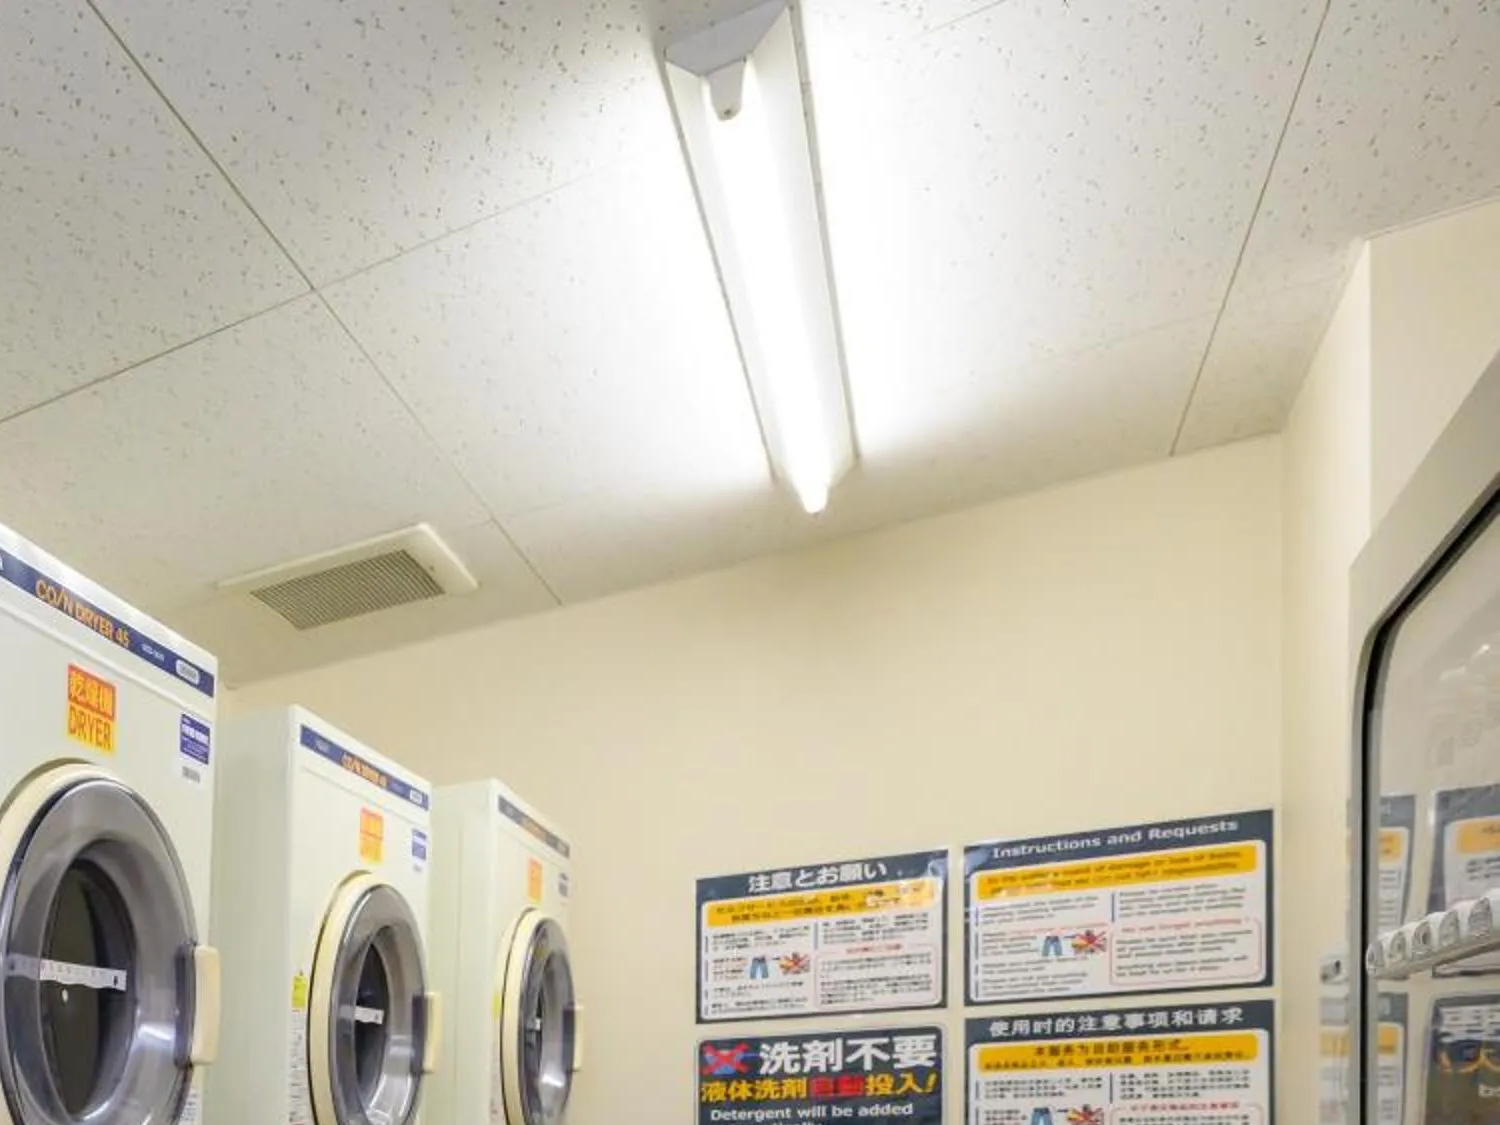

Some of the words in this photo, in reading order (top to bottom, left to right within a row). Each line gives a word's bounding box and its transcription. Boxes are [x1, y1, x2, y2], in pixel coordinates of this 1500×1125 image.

[75, 602, 114, 641] DRYER
[68, 706, 112, 750] DRYER
[992, 837, 1100, 859] Instructions
[1107, 829, 1142, 845] and
[1148, 819, 1238, 841] Requests
[748, 862, 886, 893] 注意とお願い
[989, 1007, 1244, 1038] 使用时的注意事项和请求
[759, 1035, 936, 1075] 洗剤不要
[710, 1107, 792, 1122] Detergent
[797, 1105, 826, 1118] will
[831, 1105, 853, 1117] be
[858, 1103, 914, 1117] added
